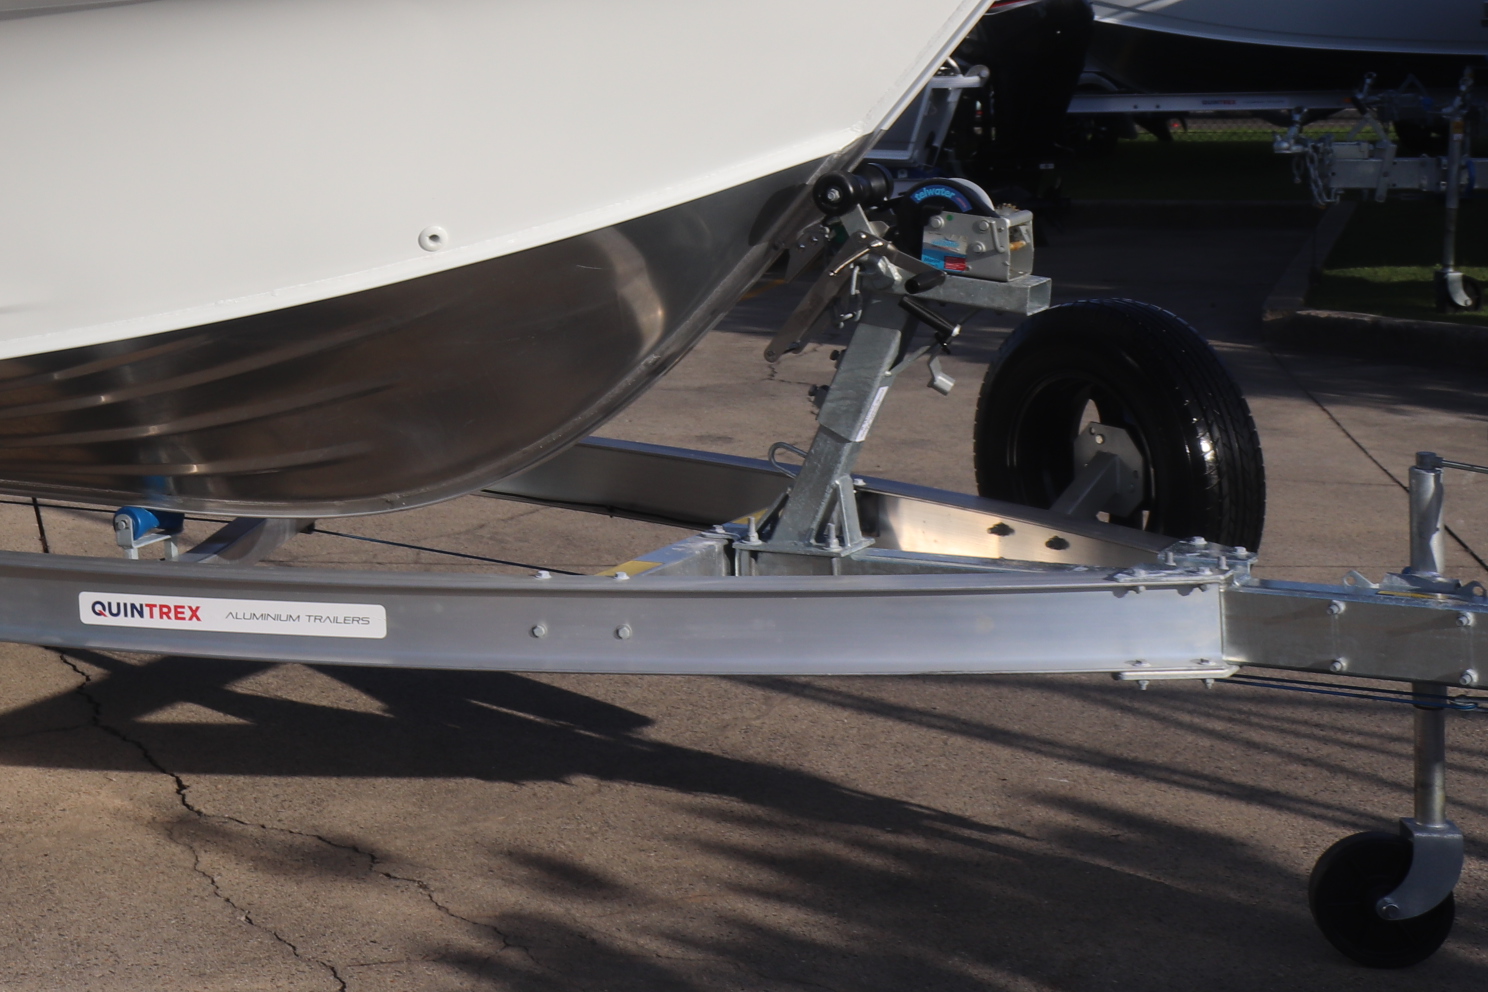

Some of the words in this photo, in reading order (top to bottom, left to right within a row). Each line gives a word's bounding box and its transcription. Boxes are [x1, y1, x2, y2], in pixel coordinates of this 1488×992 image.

[914, 187, 956, 201] telwater
[91, 600, 202, 623] QUINTREX
[225, 611, 301, 624] ALUMINIUM
[305, 614, 371, 626] TRAILERS
